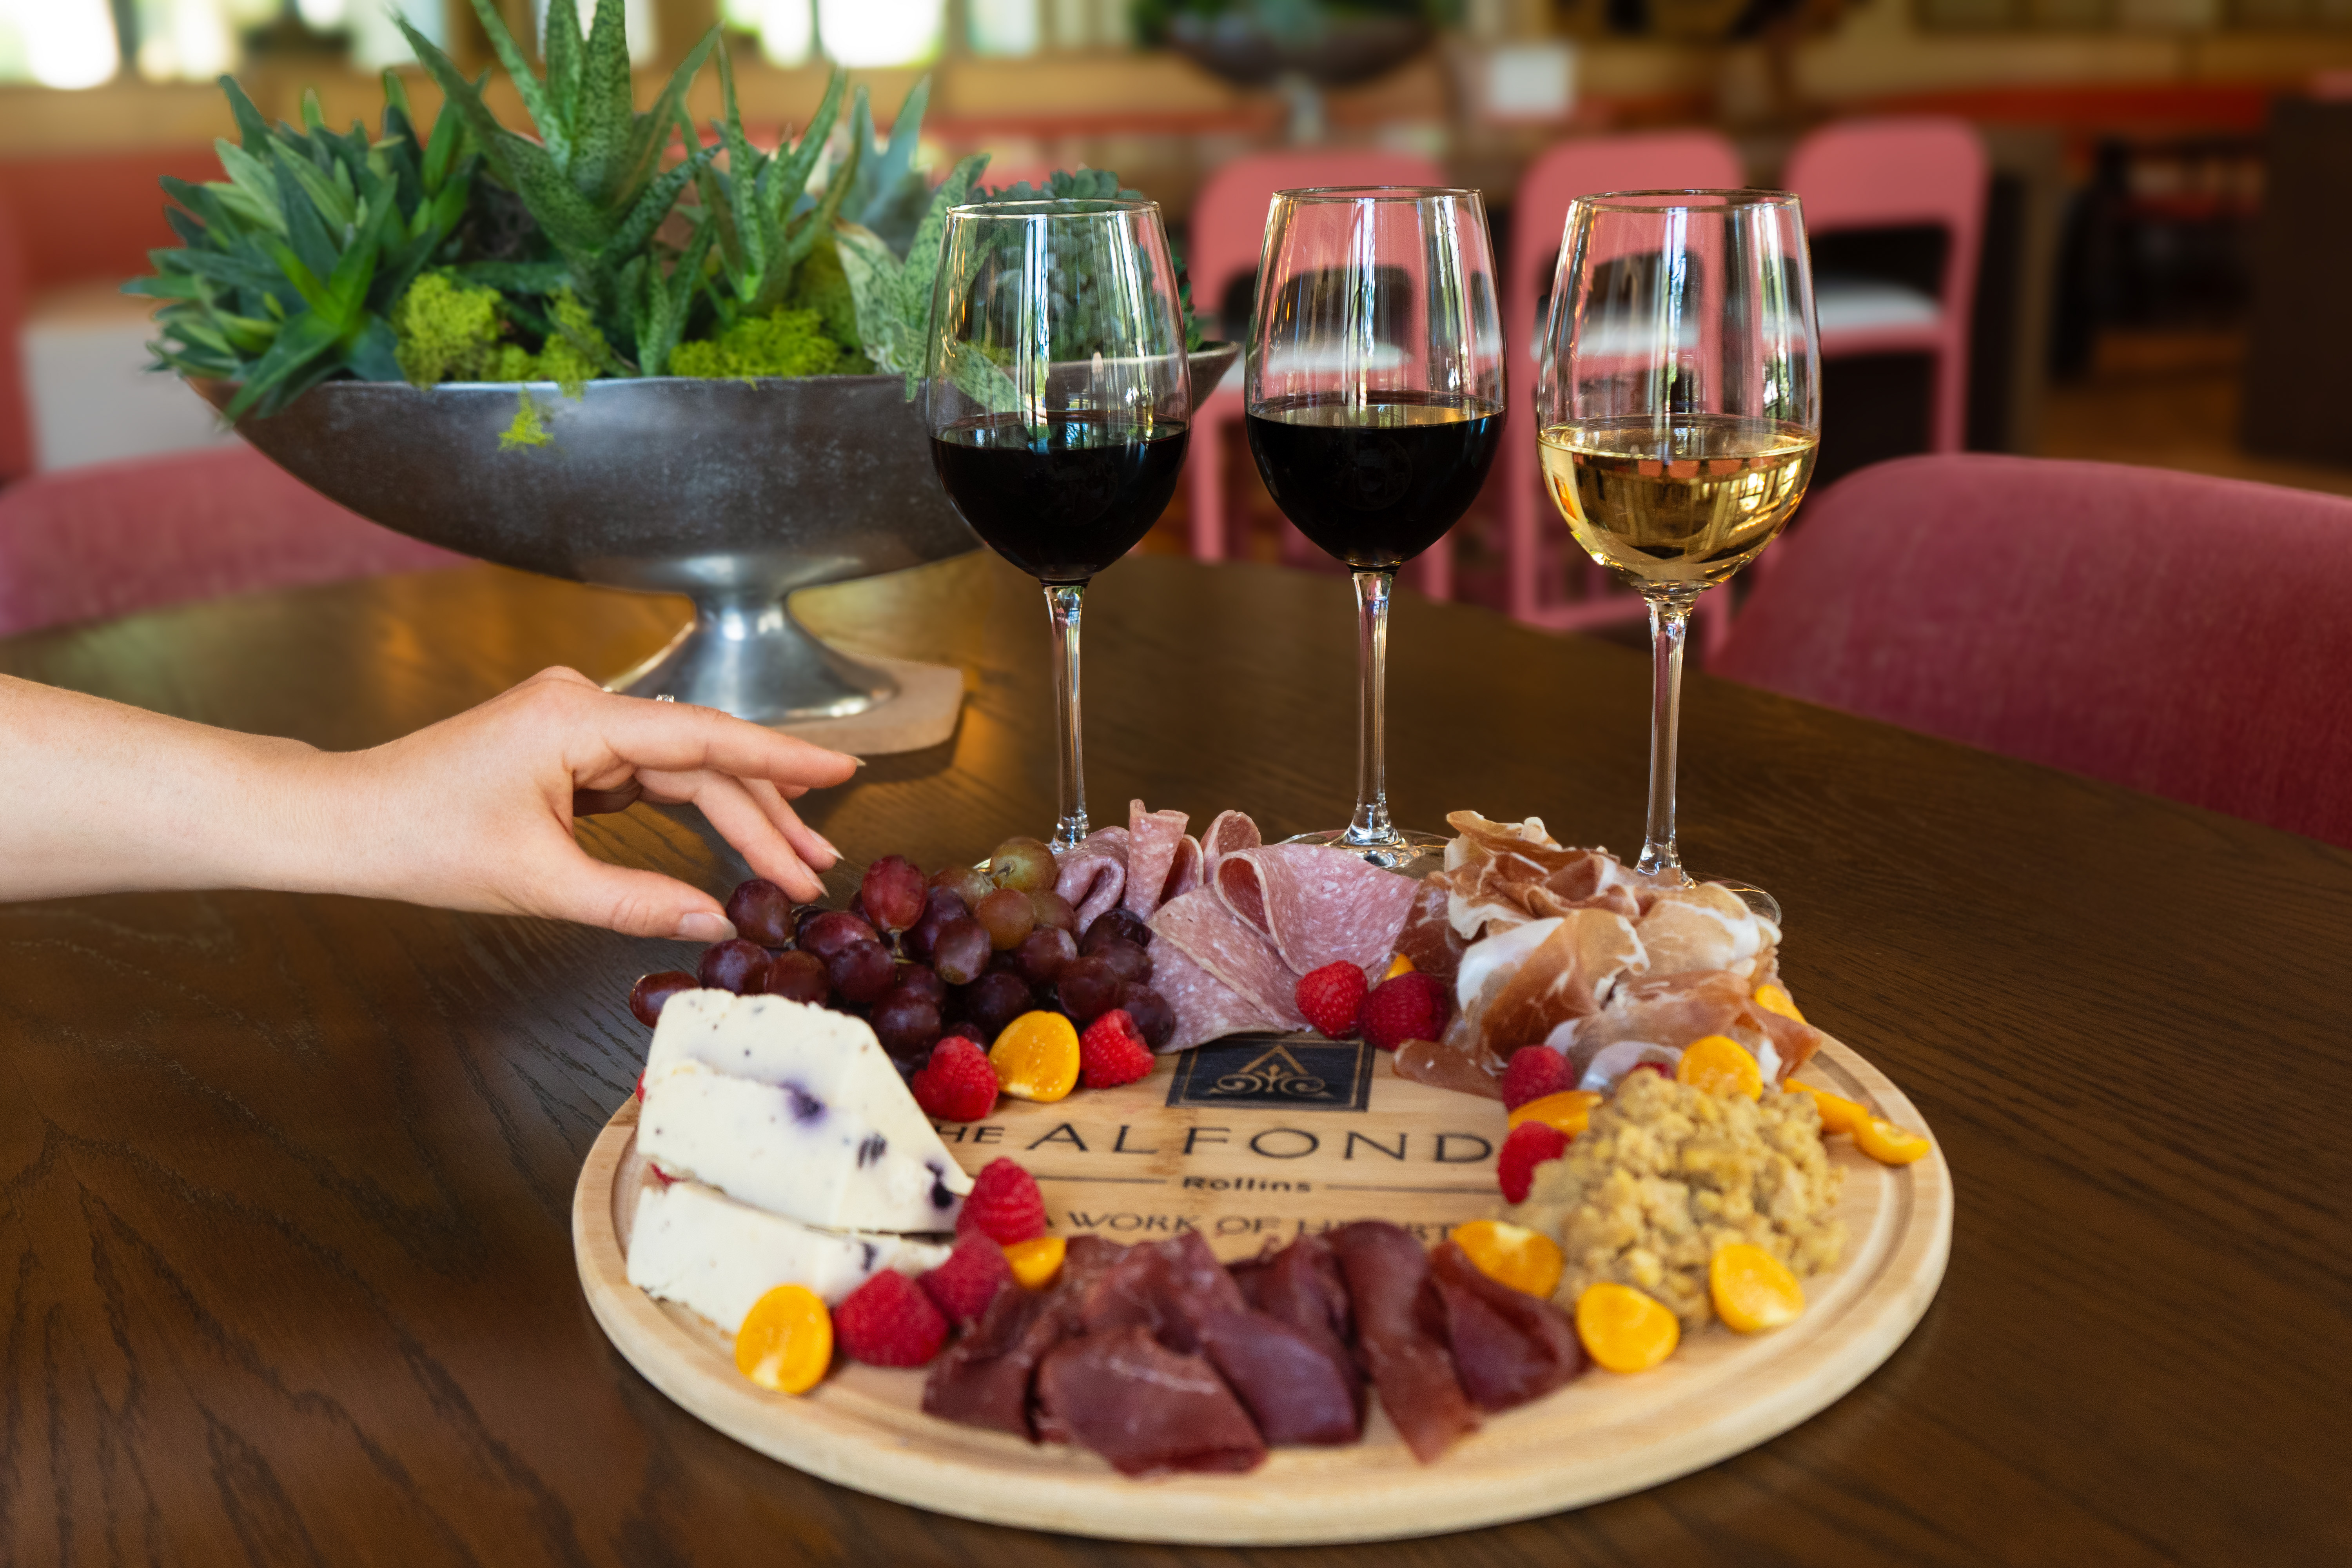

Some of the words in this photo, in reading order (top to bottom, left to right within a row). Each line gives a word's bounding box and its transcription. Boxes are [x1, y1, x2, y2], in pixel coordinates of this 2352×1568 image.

[935, 1125, 1005, 1144] HE
[1024, 1122, 1493, 1163] ALFOND
[1182, 1176, 1311, 1192] Rollins
[1068, 1211, 1202, 1232] WORK
[1216, 1216, 1281, 1234] OF
